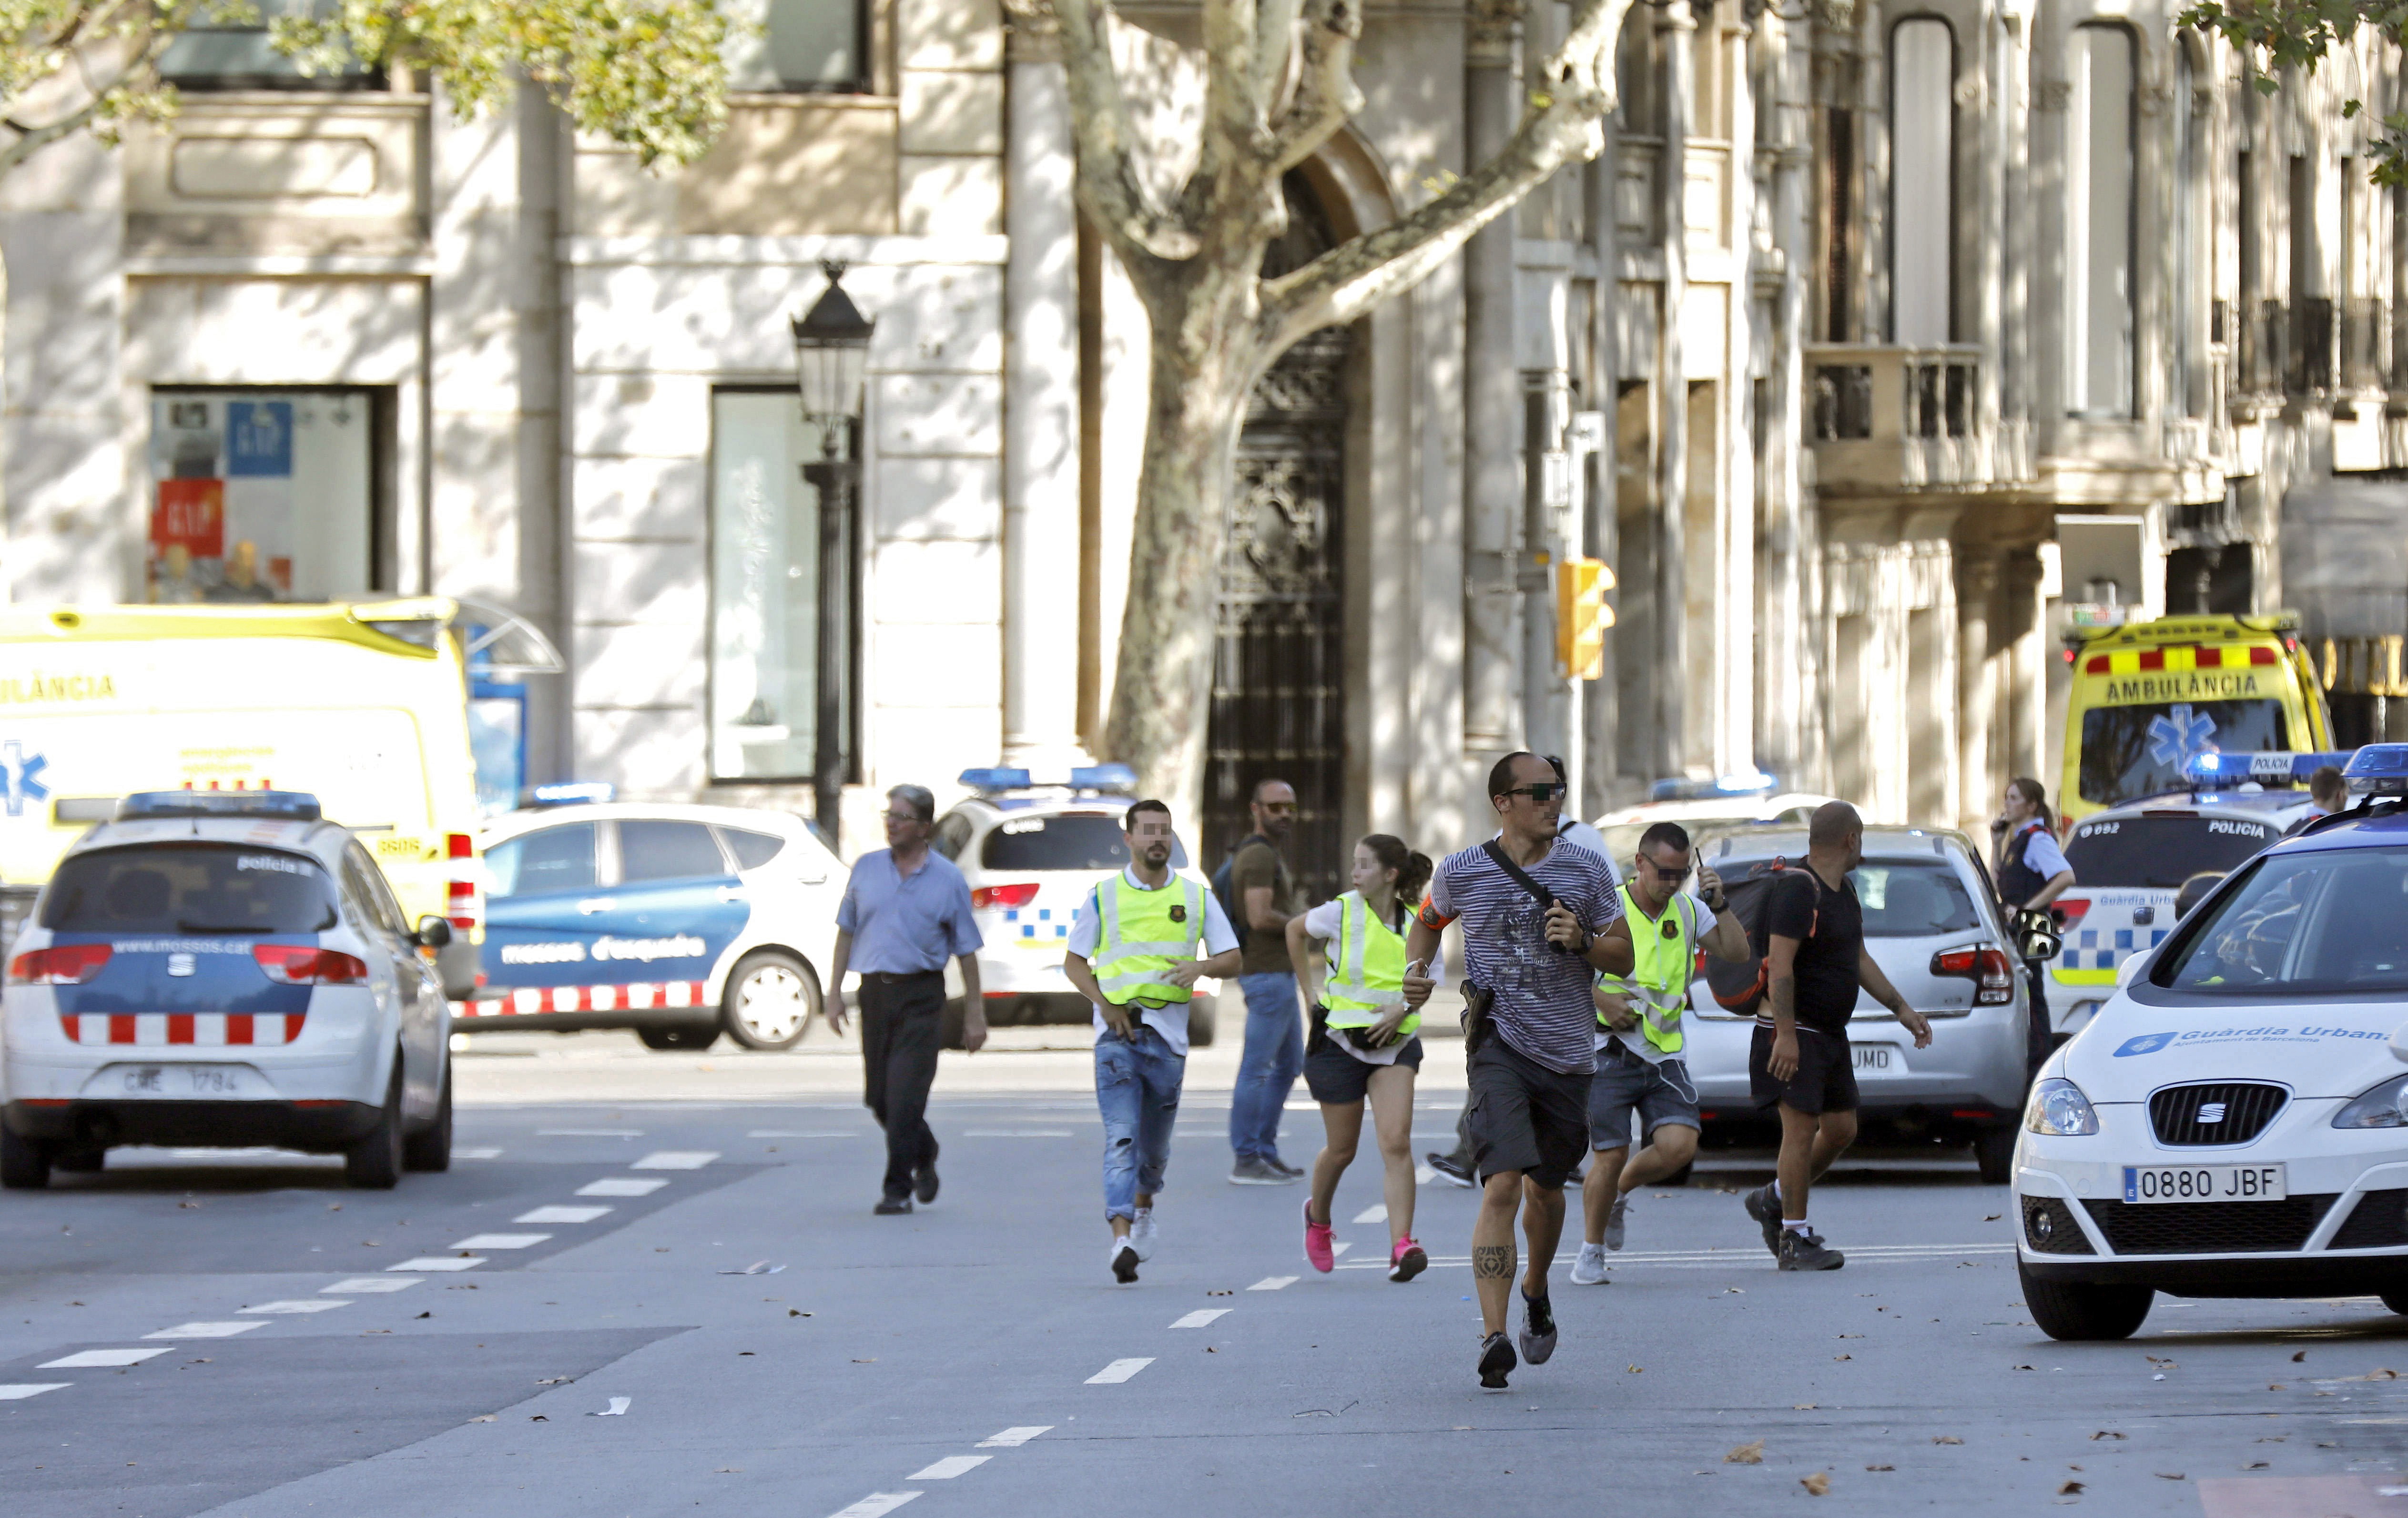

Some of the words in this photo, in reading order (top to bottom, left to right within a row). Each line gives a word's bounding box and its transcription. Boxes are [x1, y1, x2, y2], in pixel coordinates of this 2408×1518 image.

[2107, 670, 2257, 702] AMBULÀNCIA
[2255, 758, 2288, 769] POLICIA
[2094, 822, 2120, 835] 092
[2208, 820, 2265, 839] POLICIA
[112, 939, 252, 954] www.mossos.cat
[2181, 1027, 2289, 1040] Guàrdia
[1852, 1051, 1888, 1069] JMD
[2142, 1170, 2213, 1198] 0880
[2225, 1169, 2276, 1196] JBF
[2128, 1189, 2134, 1197] E
